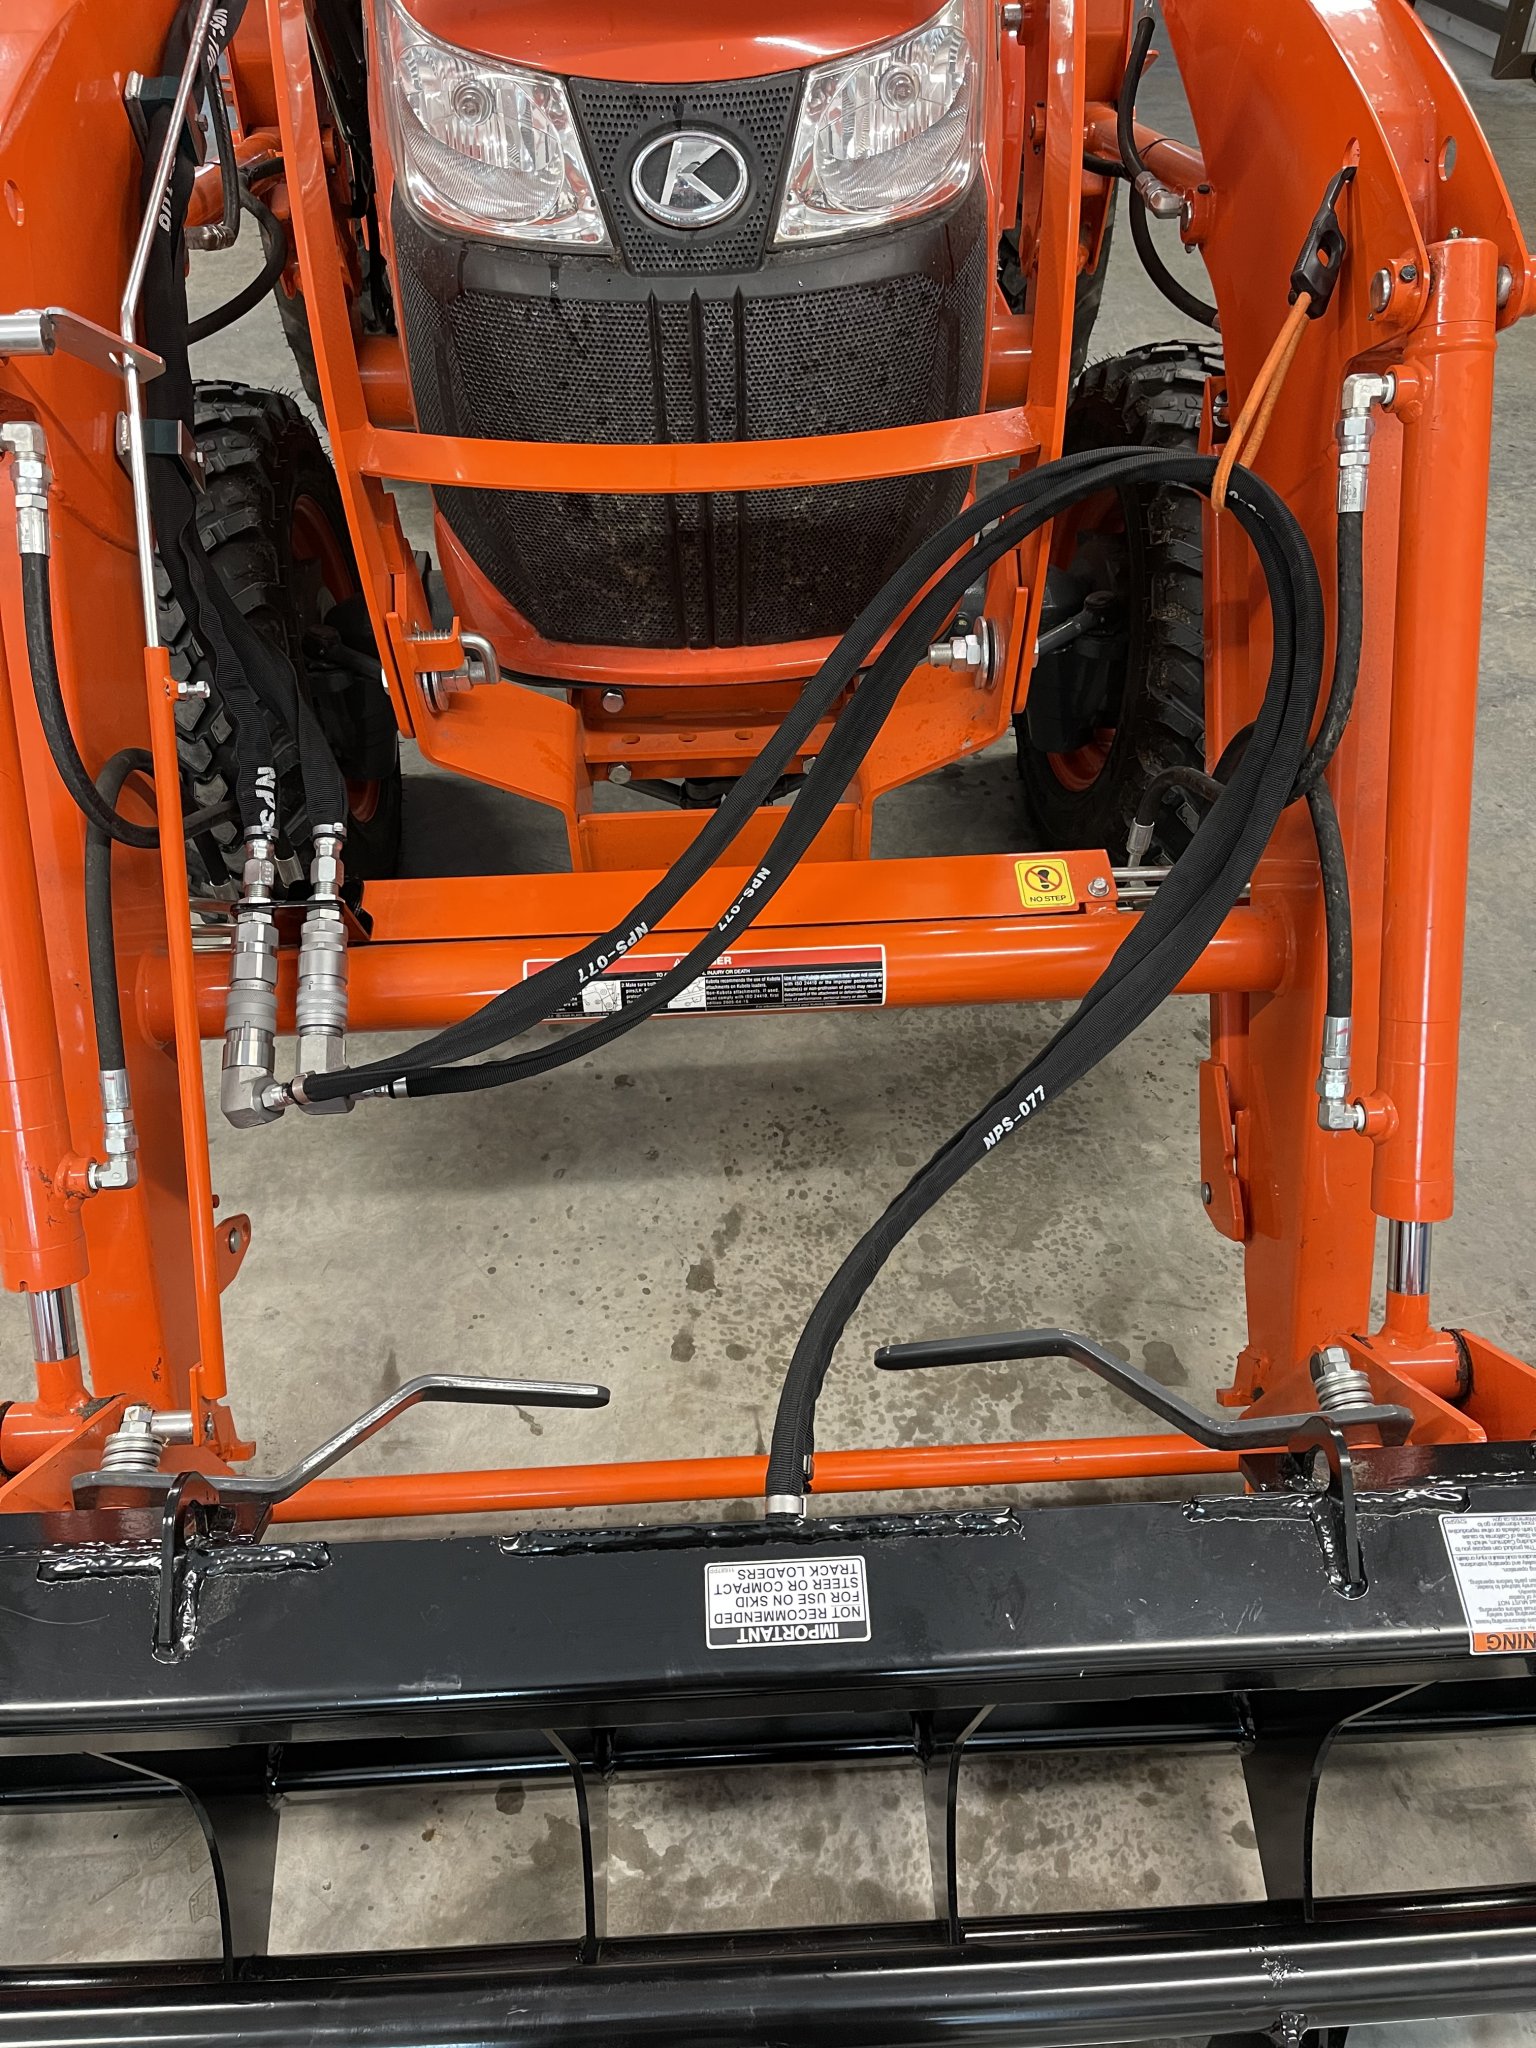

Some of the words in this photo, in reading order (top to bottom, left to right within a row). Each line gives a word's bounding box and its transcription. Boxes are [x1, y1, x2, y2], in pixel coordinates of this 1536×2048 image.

[718, 867, 771, 932] NPS-077
[578, 922, 648, 983] NPS-077
[983, 1084, 1045, 1150] NPS-077
[737, 1566, 804, 1580] LOADERS
[809, 1564, 858, 1576] TRACK
[714, 1581, 783, 1595] COMPACT
[787, 1580, 808, 1591] OR
[812, 1577, 858, 1589] STEER
[736, 1596, 768, 1607] SKID
[774, 1594, 793, 1606] ON
[798, 1592, 826, 1604] USE
[830, 1591, 859, 1602] FOR
[714, 1608, 827, 1624] RECOMMENDED
[832, 1606, 860, 1618] NOT
[736, 1623, 839, 1643] IMPORTANT
[1486, 1633, 1536, 1650] NING
